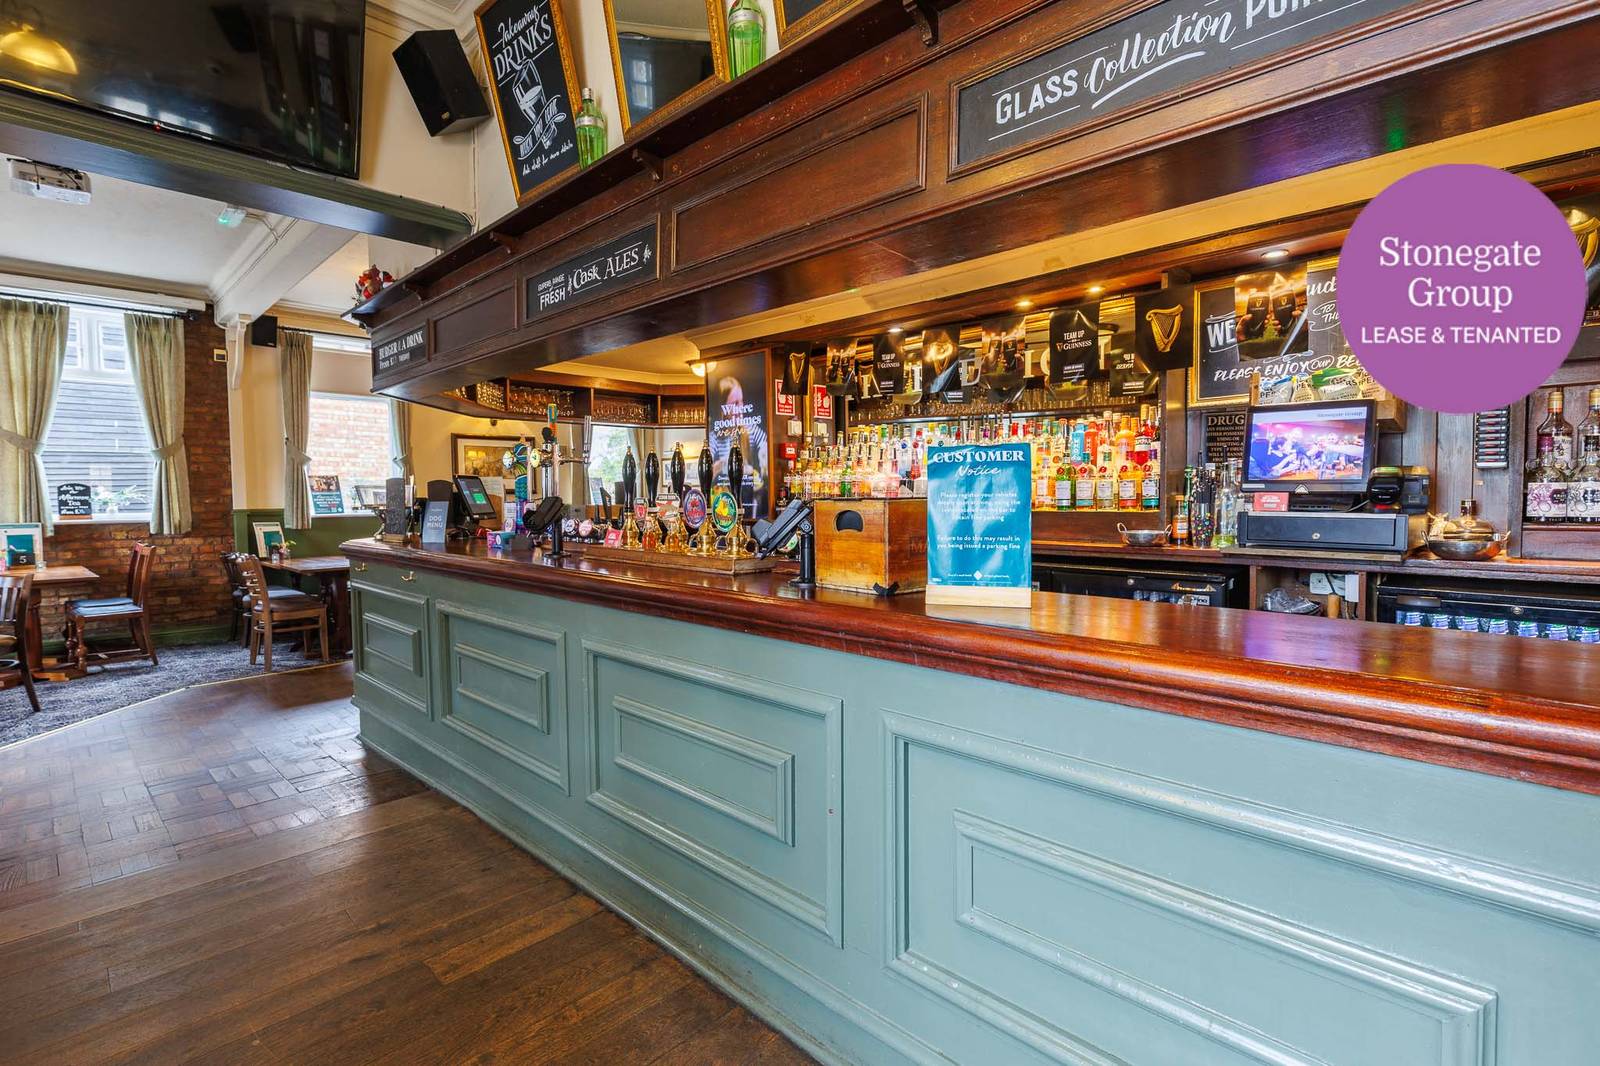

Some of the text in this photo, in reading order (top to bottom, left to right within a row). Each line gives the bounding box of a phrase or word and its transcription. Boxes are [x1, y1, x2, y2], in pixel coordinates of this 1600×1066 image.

[498, 5, 540, 48] Takeaway
[494, 13, 552, 80] DRINKS
[994, 69, 1079, 124] GLASS
[1084, 11, 1236, 94] Collection
[572, 247, 639, 289] Cask ALES
[540, 287, 566, 311] FRESH
[1063, 329, 1085, 340] TEAM UP
[1206, 319, 1237, 348] WE
[1063, 340, 1092, 350] GUINNESS
[1264, 361, 1310, 377] ENJOY
[721, 403, 754, 416] Where
[714, 413, 762, 431] good times
[1208, 415, 1245, 426] DRUG
[933, 450, 1025, 463] CUSTOMER
[954, 464, 1001, 478] Notice
[986, 543, 1008, 551] parking
[19, 555, 27, 564] 5
